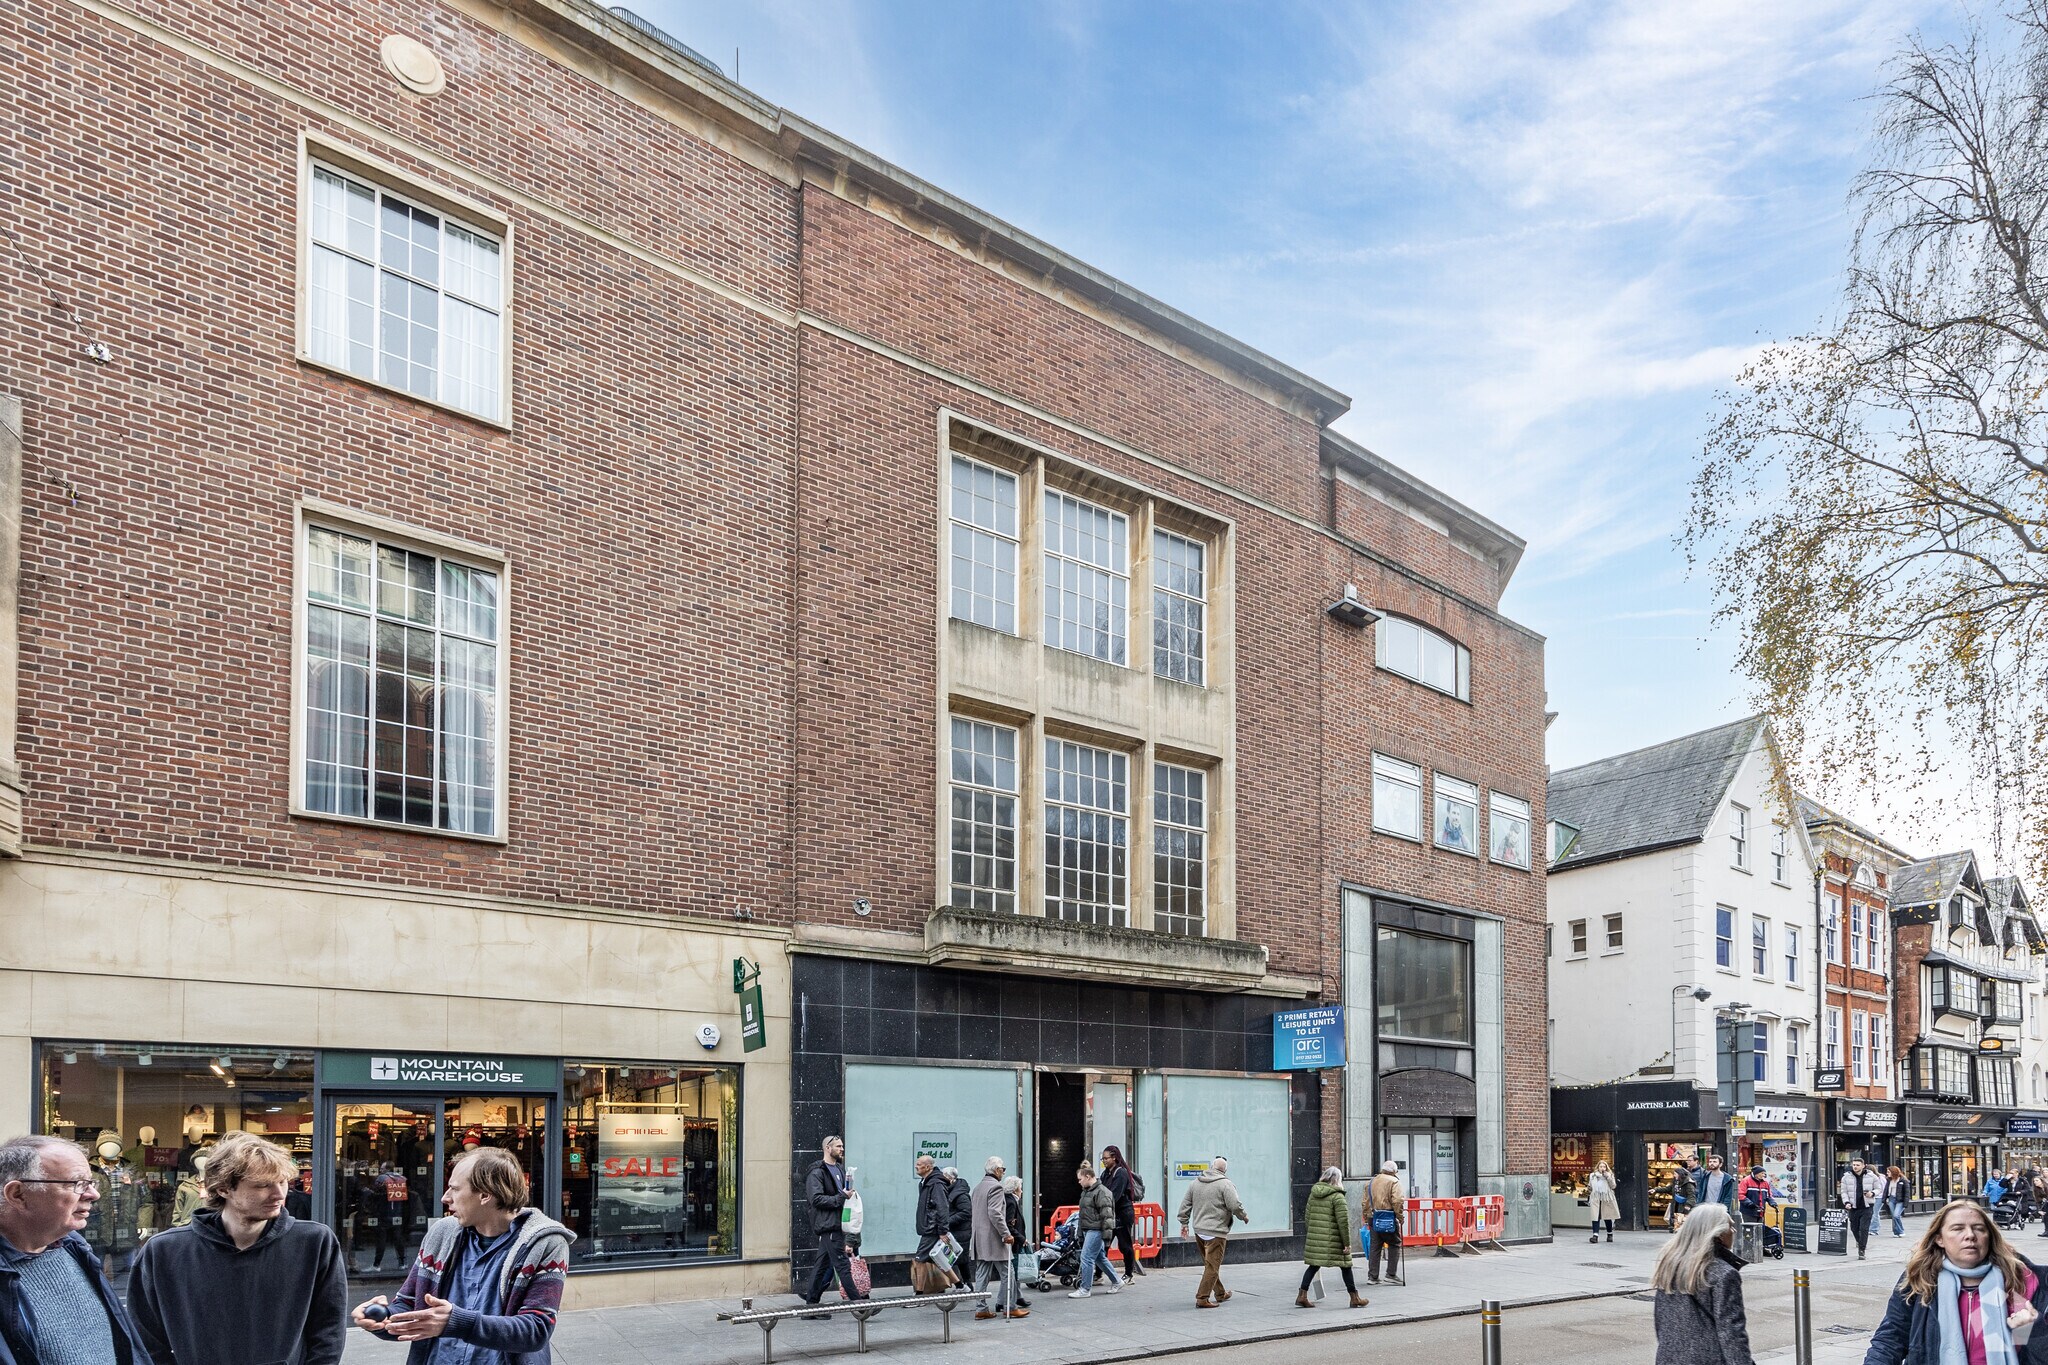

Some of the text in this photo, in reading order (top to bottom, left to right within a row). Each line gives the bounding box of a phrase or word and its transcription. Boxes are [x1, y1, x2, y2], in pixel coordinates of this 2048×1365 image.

[1284, 1012, 1307, 1021] PRIME
[1309, 1010, 1334, 1018] RETAIL
[1282, 1020, 1310, 1028] LEISURE
[1297, 1040, 1320, 1050] arc
[401, 1058, 504, 1070] MOUNTAIN
[400, 1070, 524, 1083] WAREHOUSE
[939, 1150, 953, 1158] Ltd
[604, 1157, 678, 1178] SALE
